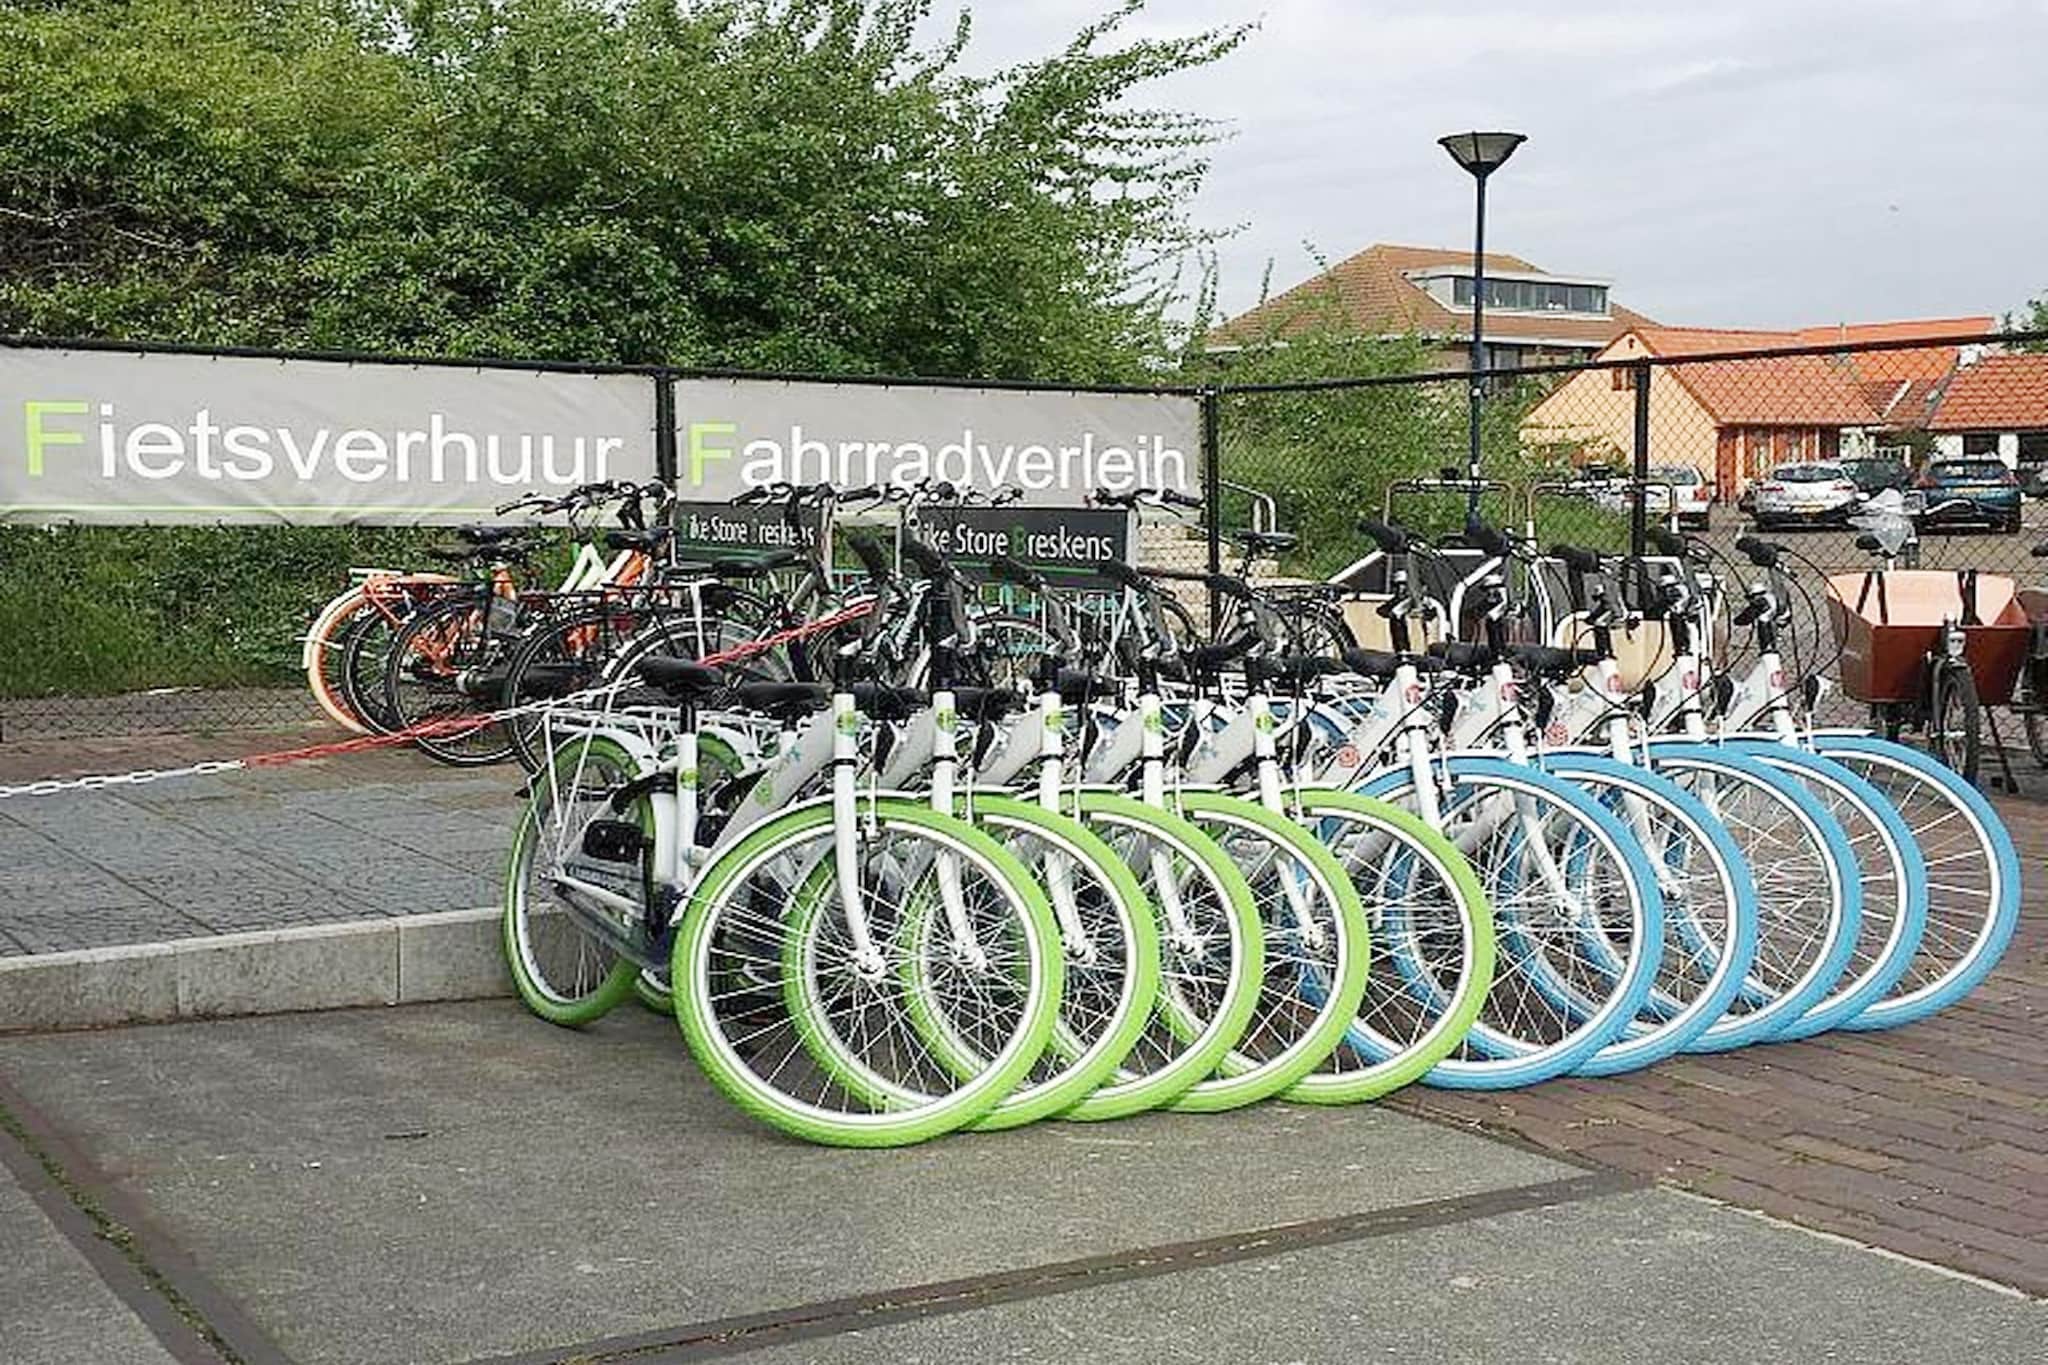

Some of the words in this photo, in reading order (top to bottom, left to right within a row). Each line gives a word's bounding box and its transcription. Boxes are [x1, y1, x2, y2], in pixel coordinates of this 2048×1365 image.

[24, 400, 624, 484] Fietsverhuur
[688, 422, 1188, 492] Fahrradverleih
[921, 521, 950, 554] ike
[956, 523, 1008, 556] Store
[1011, 525, 1114, 561] Breskens
